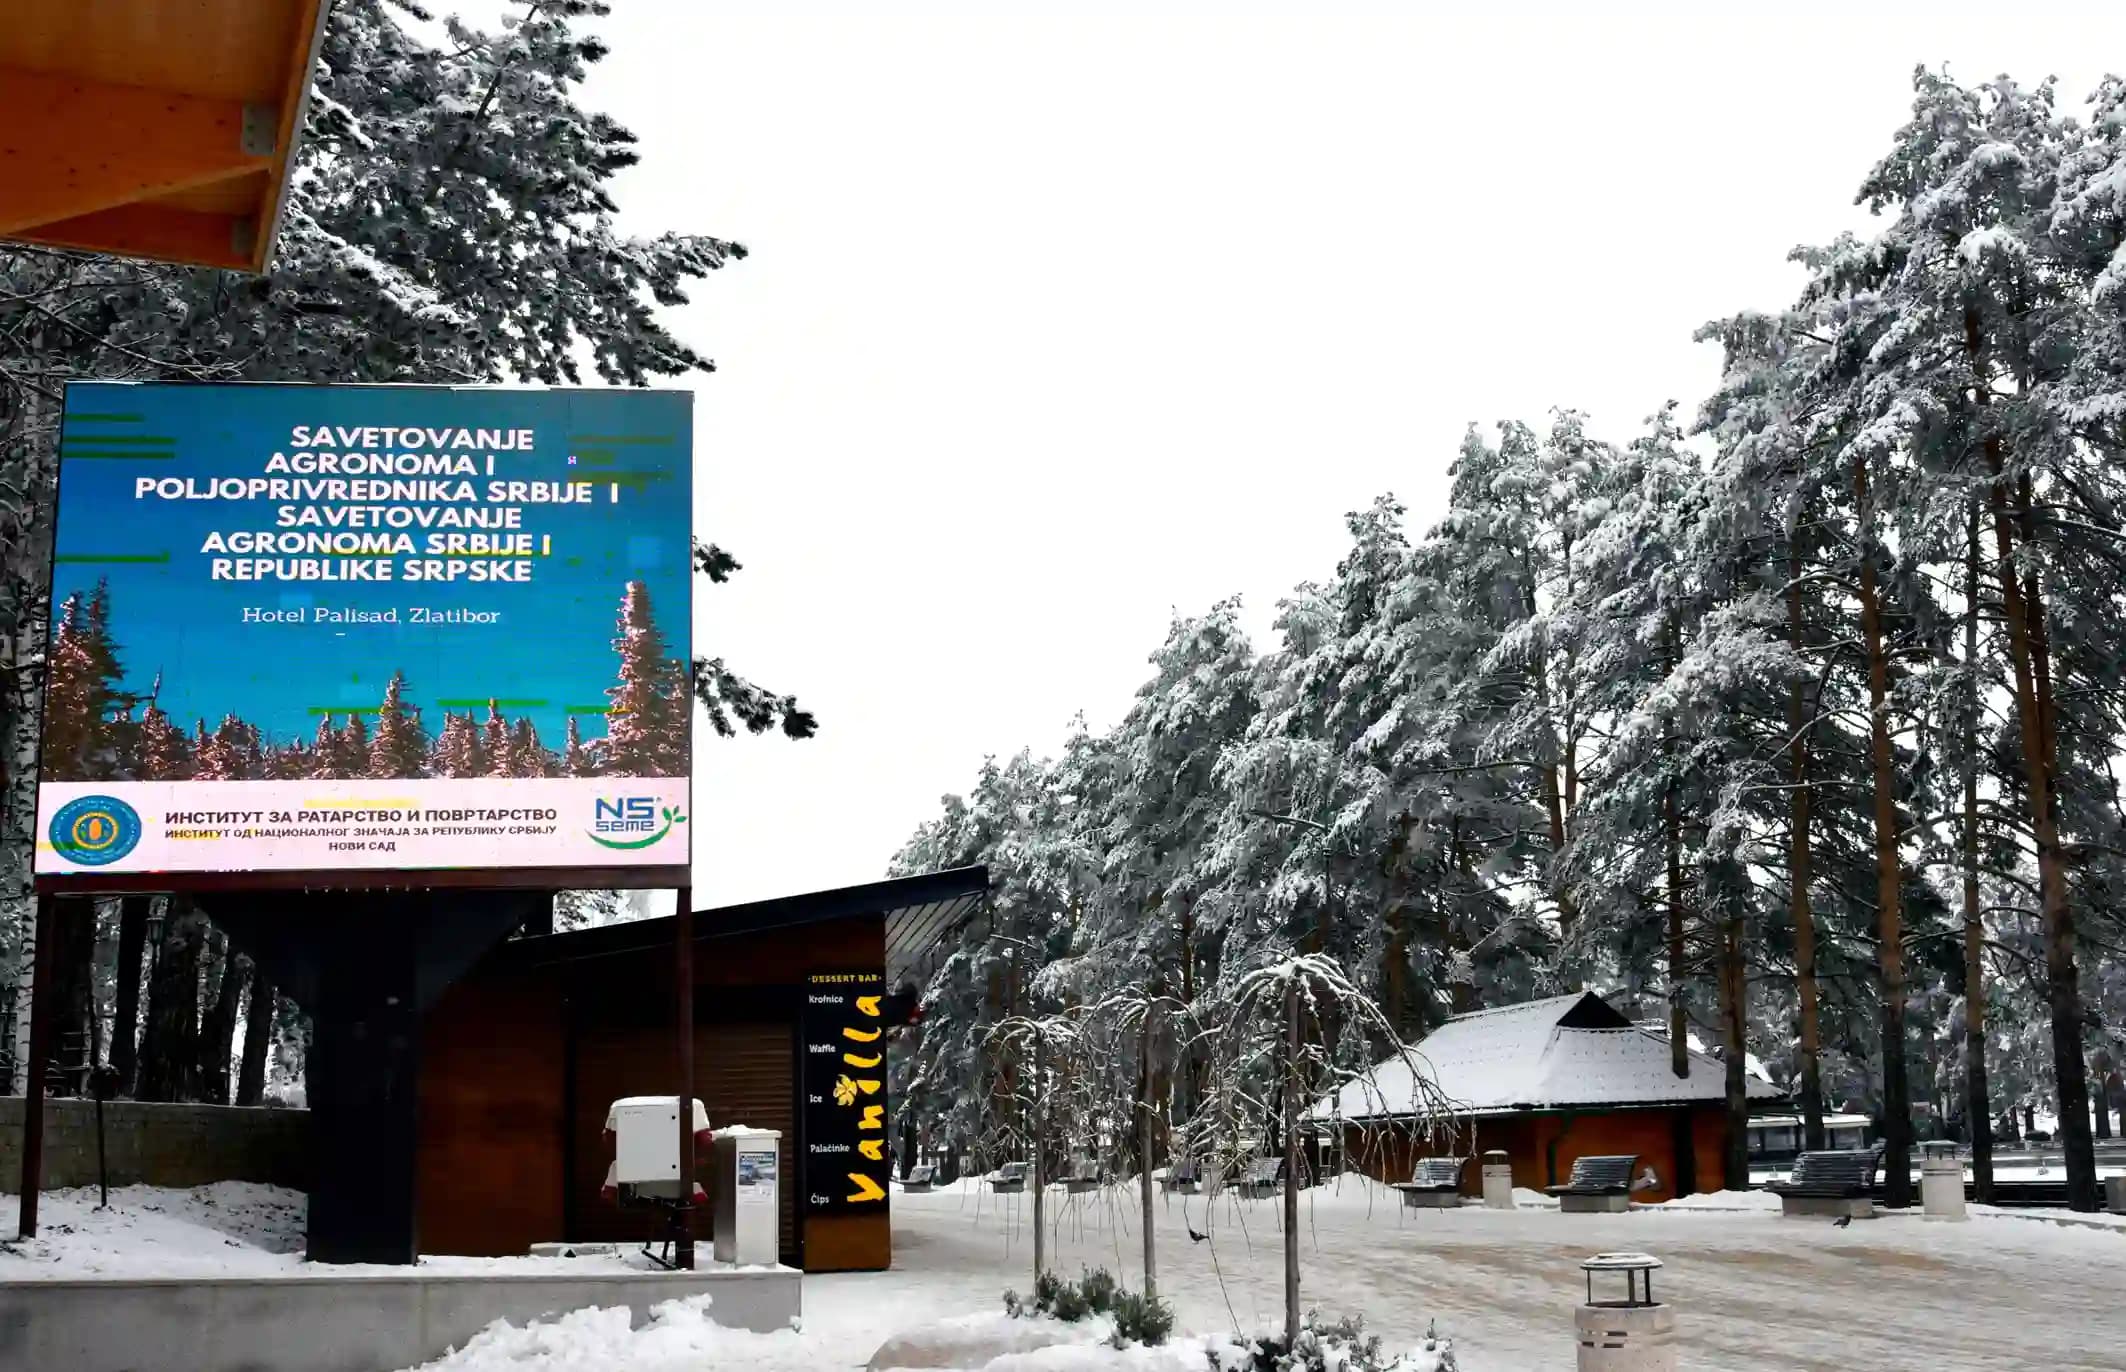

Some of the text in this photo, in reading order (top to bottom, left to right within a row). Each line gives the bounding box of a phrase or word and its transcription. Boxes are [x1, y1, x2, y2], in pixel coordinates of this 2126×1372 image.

[291, 426, 534, 450] SAVETOVANJE
[265, 452, 495, 475] AGRONOMA I
[135, 478, 618, 503] POLJOPRIVREDNIKA SRBIJE I
[276, 505, 522, 529] SAVETOVANJE
[201, 531, 551, 555] AGRONOMA SRBIJE I
[211, 559, 532, 582] REPUBLIKE SRPSKE
[242, 607, 501, 625] Hotel Palisad, Zlatibor
[165, 808, 557, 824] ИНСТИТУТ ЗА РАТАРСТВО И ПОВРТАРСТВО
[595, 797, 655, 820] NS
[165, 825, 557, 840] ИНСТИТУТ ОД НАЦИОНАЛНОГ ЗНАЧАЈА ЗА РЕПУБЛИКУ СРБИЈУ
[329, 841, 396, 852] НОВИ САД
[811, 974, 878, 983] DESSERT BAR
[808, 994, 844, 1004] Krofnice
[808, 1043, 836, 1053] Waffle
[809, 1093, 823, 1103] Ice
[810, 1192, 830, 1205] Čips
